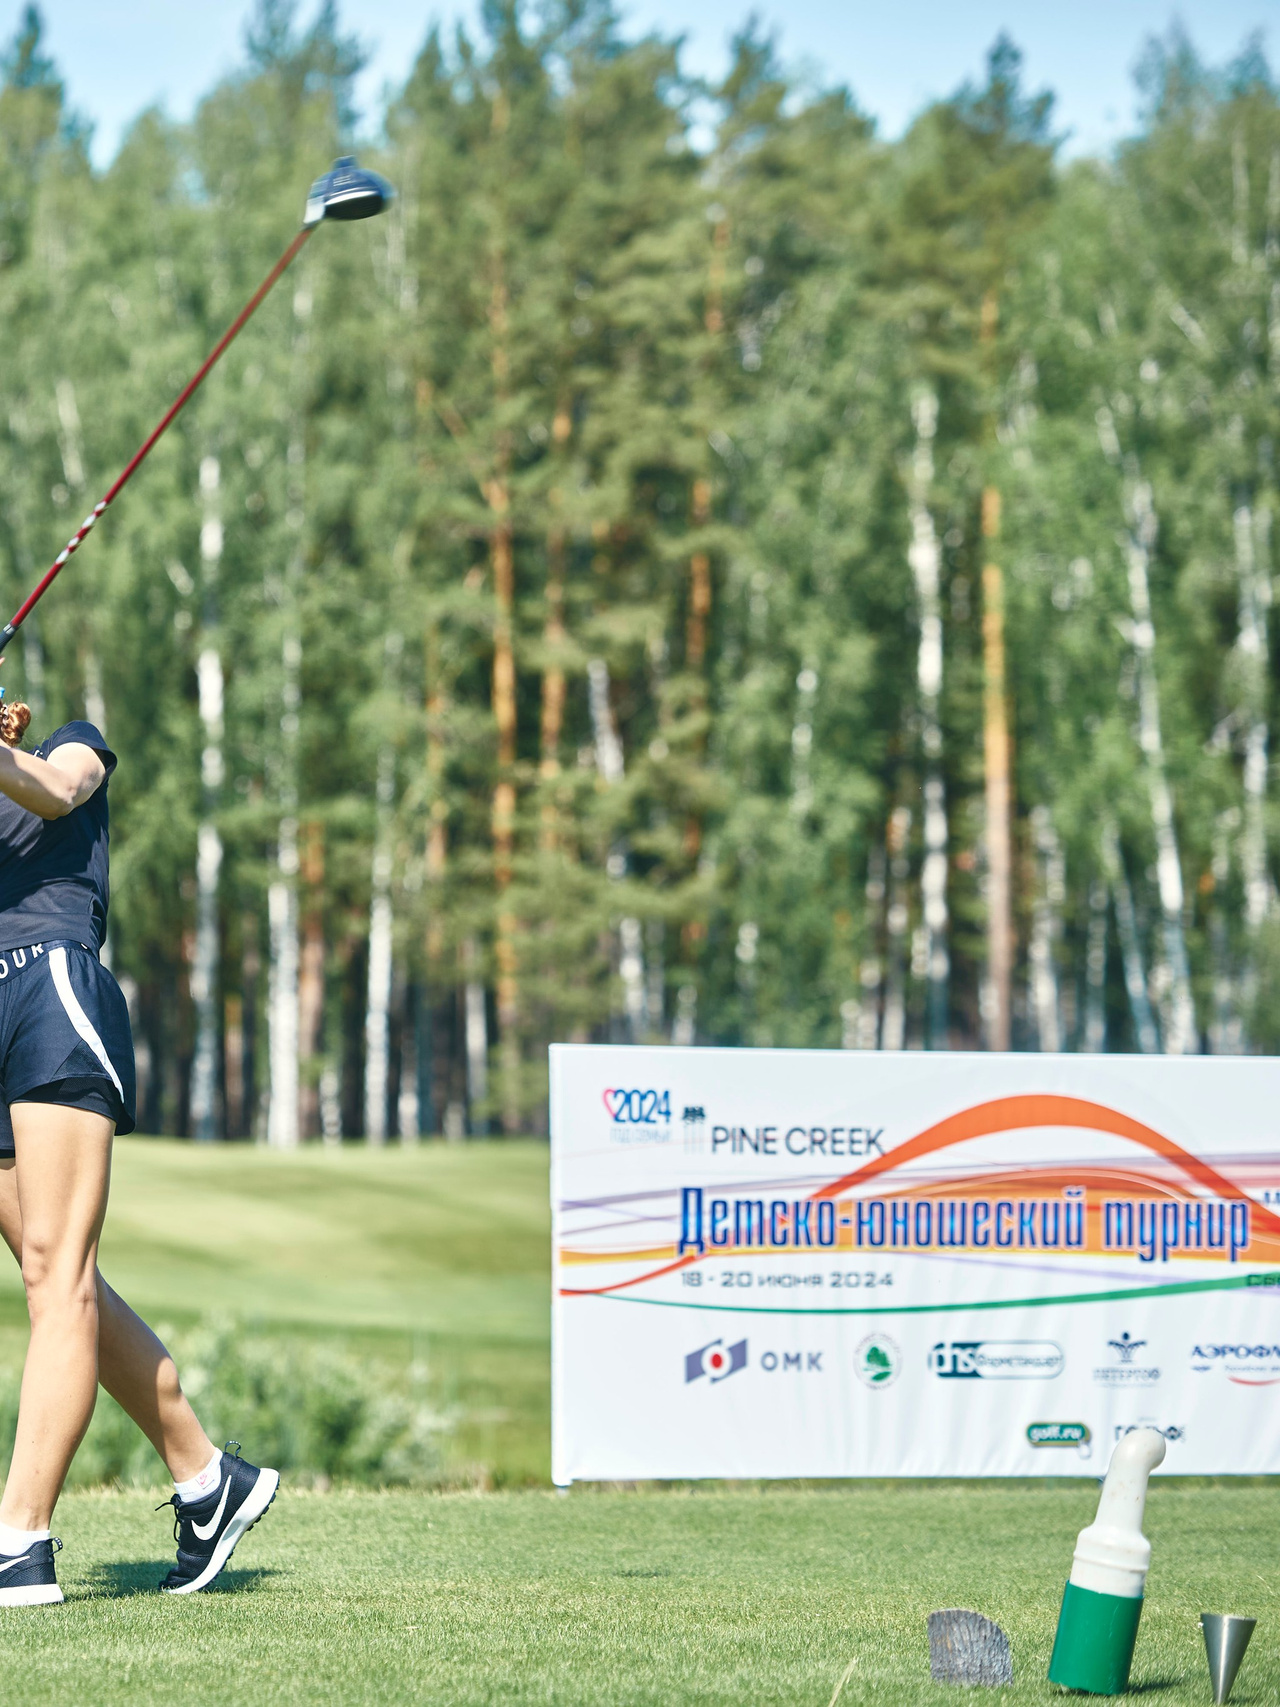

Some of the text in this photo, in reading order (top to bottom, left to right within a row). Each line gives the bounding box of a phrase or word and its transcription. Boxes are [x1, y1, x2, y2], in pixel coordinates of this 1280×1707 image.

[612, 1089, 672, 1124] 2024
[711, 1127, 886, 1156] PINE CREEK
[677, 1187, 1249, 1263] Детско-юношеский турнир
[682, 1271, 703, 1288] 18
[720, 1271, 753, 1288] 20
[829, 1271, 895, 1288] 2024
[760, 1351, 823, 1372] ОМК
